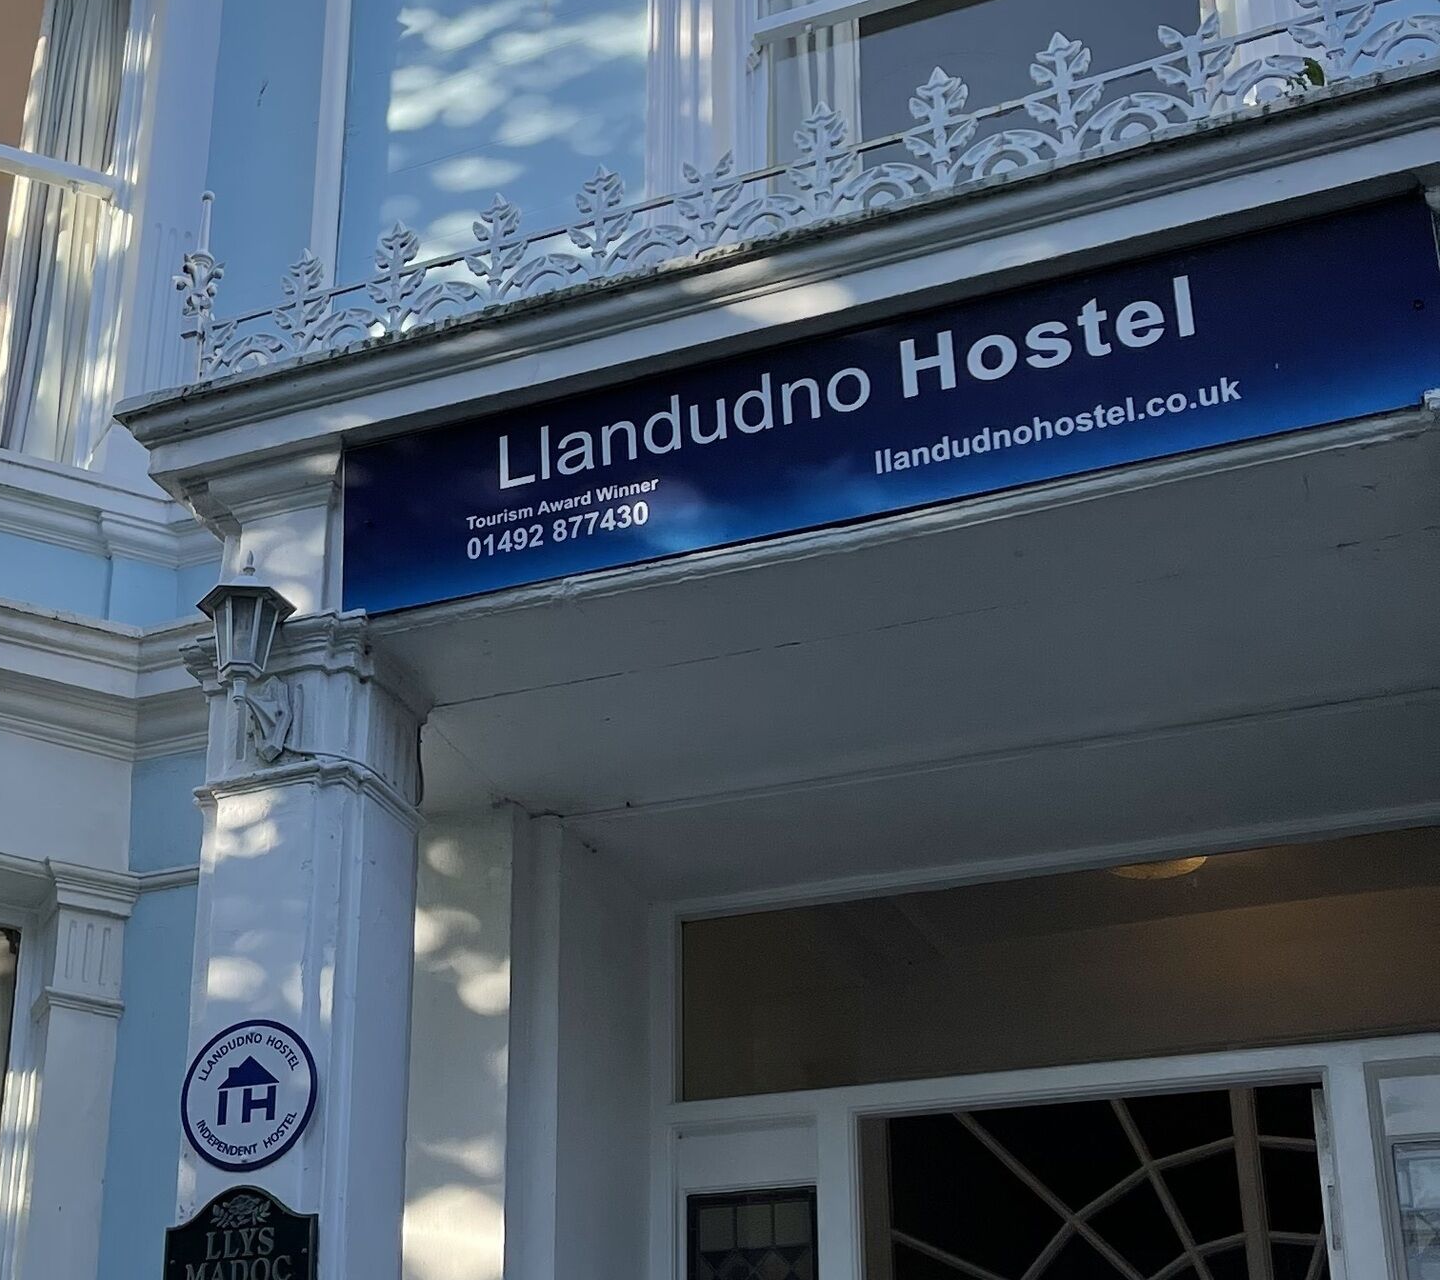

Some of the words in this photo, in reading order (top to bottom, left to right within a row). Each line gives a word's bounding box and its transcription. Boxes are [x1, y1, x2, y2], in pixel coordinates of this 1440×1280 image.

[498, 365, 871, 490] Llandudno
[899, 275, 1197, 399] Hostel
[875, 376, 1242, 474] llandudnohostel.co.uk
[466, 506, 533, 531] Tourism
[537, 491, 591, 516] Award
[596, 478, 659, 502] Winner
[467, 524, 544, 560] 01492
[553, 501, 649, 543] 877430
[198, 1032, 263, 1081] LLANDUDNO
[266, 1035, 300, 1072] HOSTEL
[196, 1119, 258, 1156] INDEPENDENT
[263, 1110, 297, 1149] HOSTEL
[205, 1226, 275, 1261] LLYS
